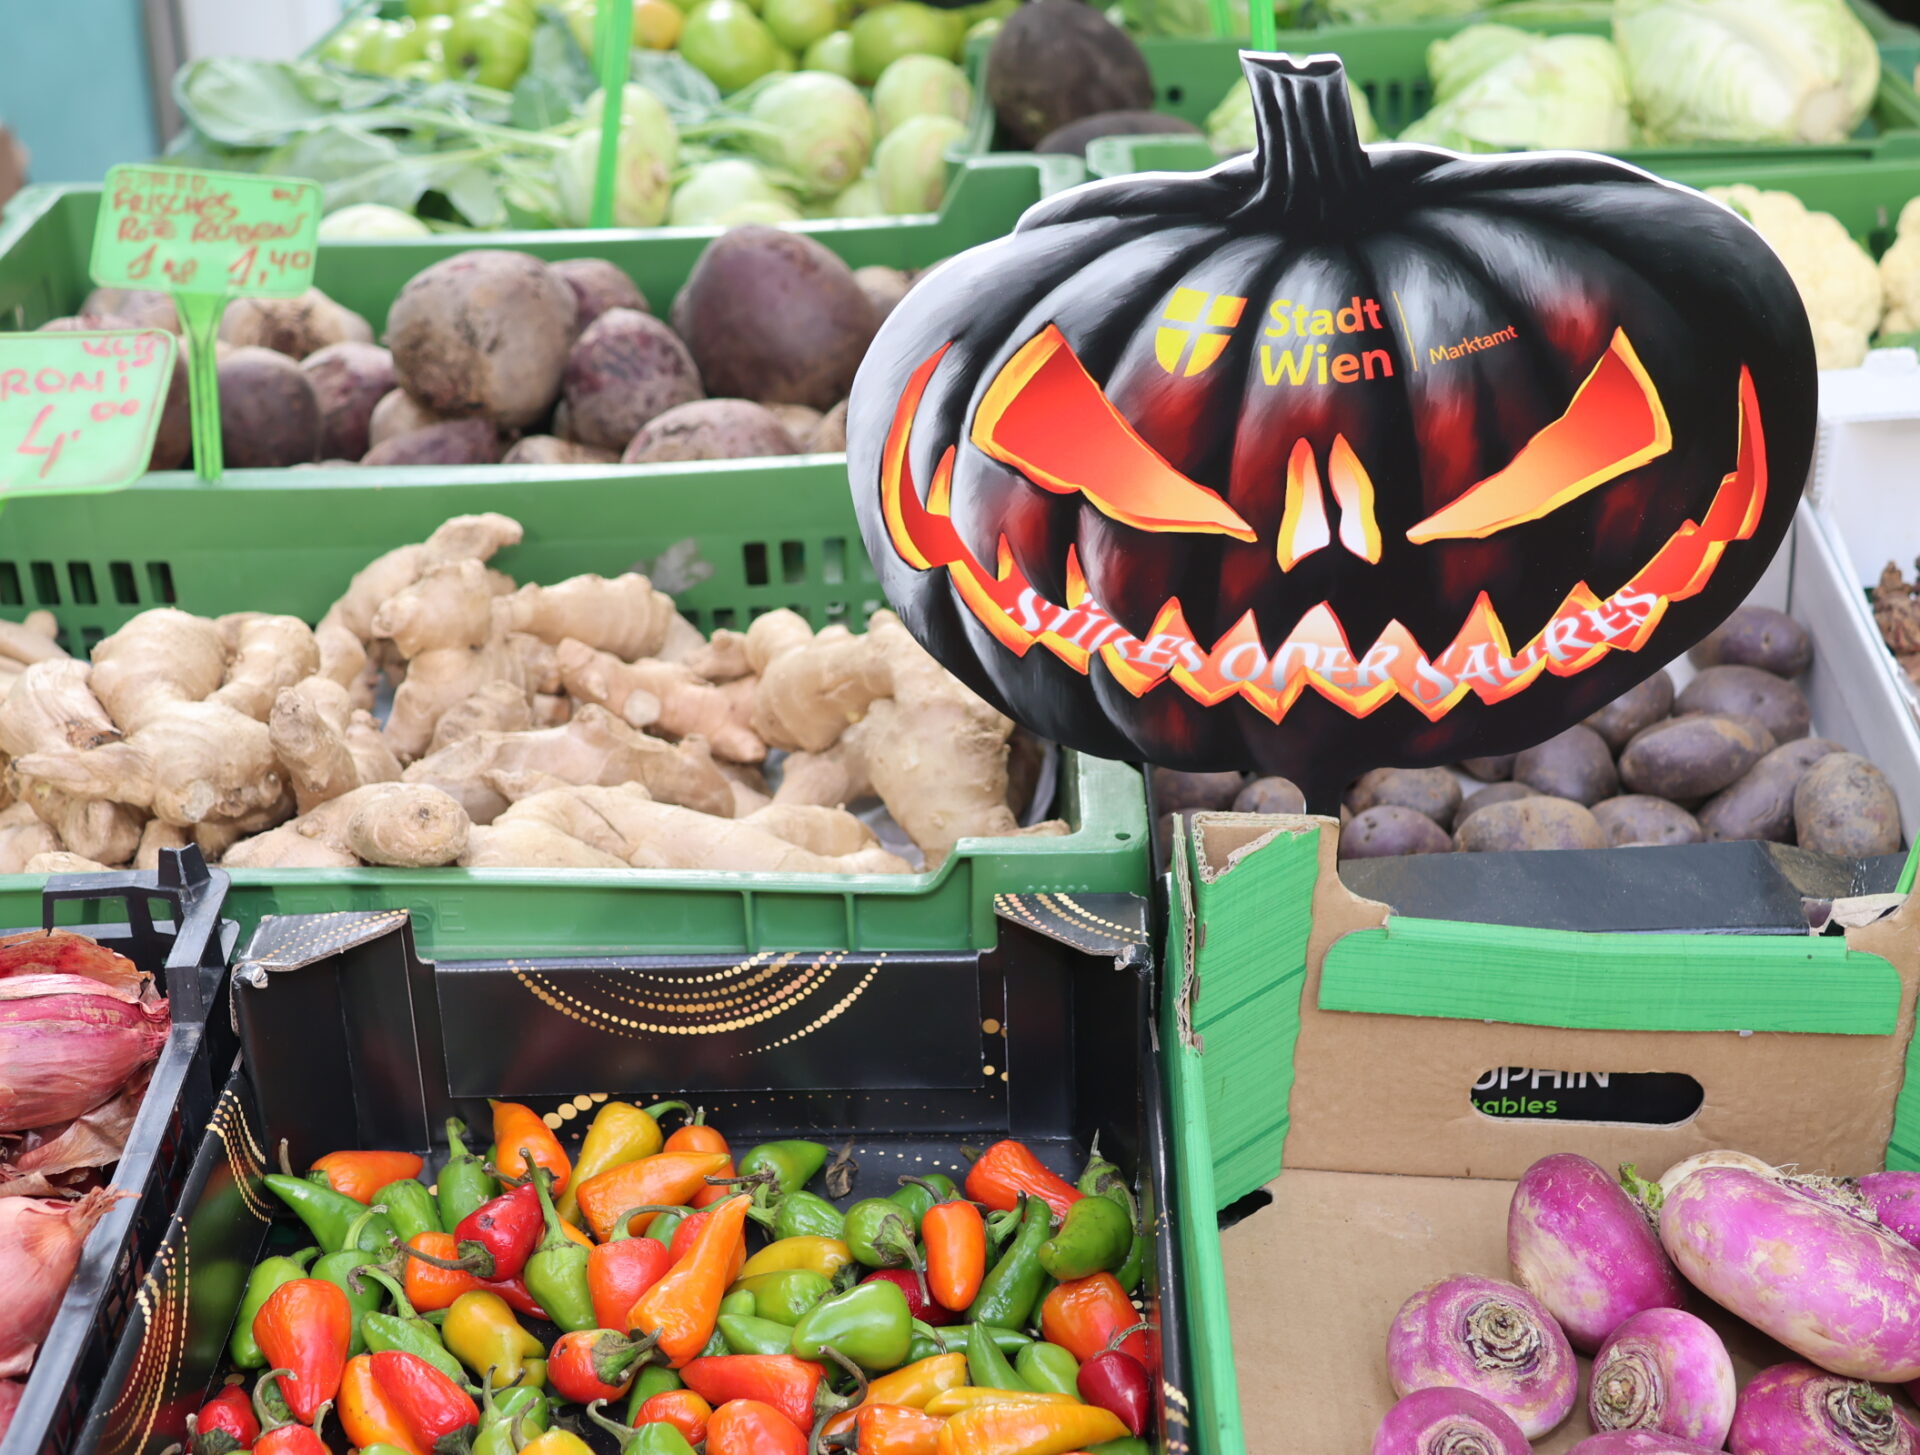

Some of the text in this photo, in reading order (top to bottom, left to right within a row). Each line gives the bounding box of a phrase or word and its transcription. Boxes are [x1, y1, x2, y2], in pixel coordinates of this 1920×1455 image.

[1264, 296, 1384, 338] Stadt
[1428, 324, 1519, 365] Marktamt
[1260, 345, 1395, 387] Wien
[1413, 585, 1659, 705] SAURES
